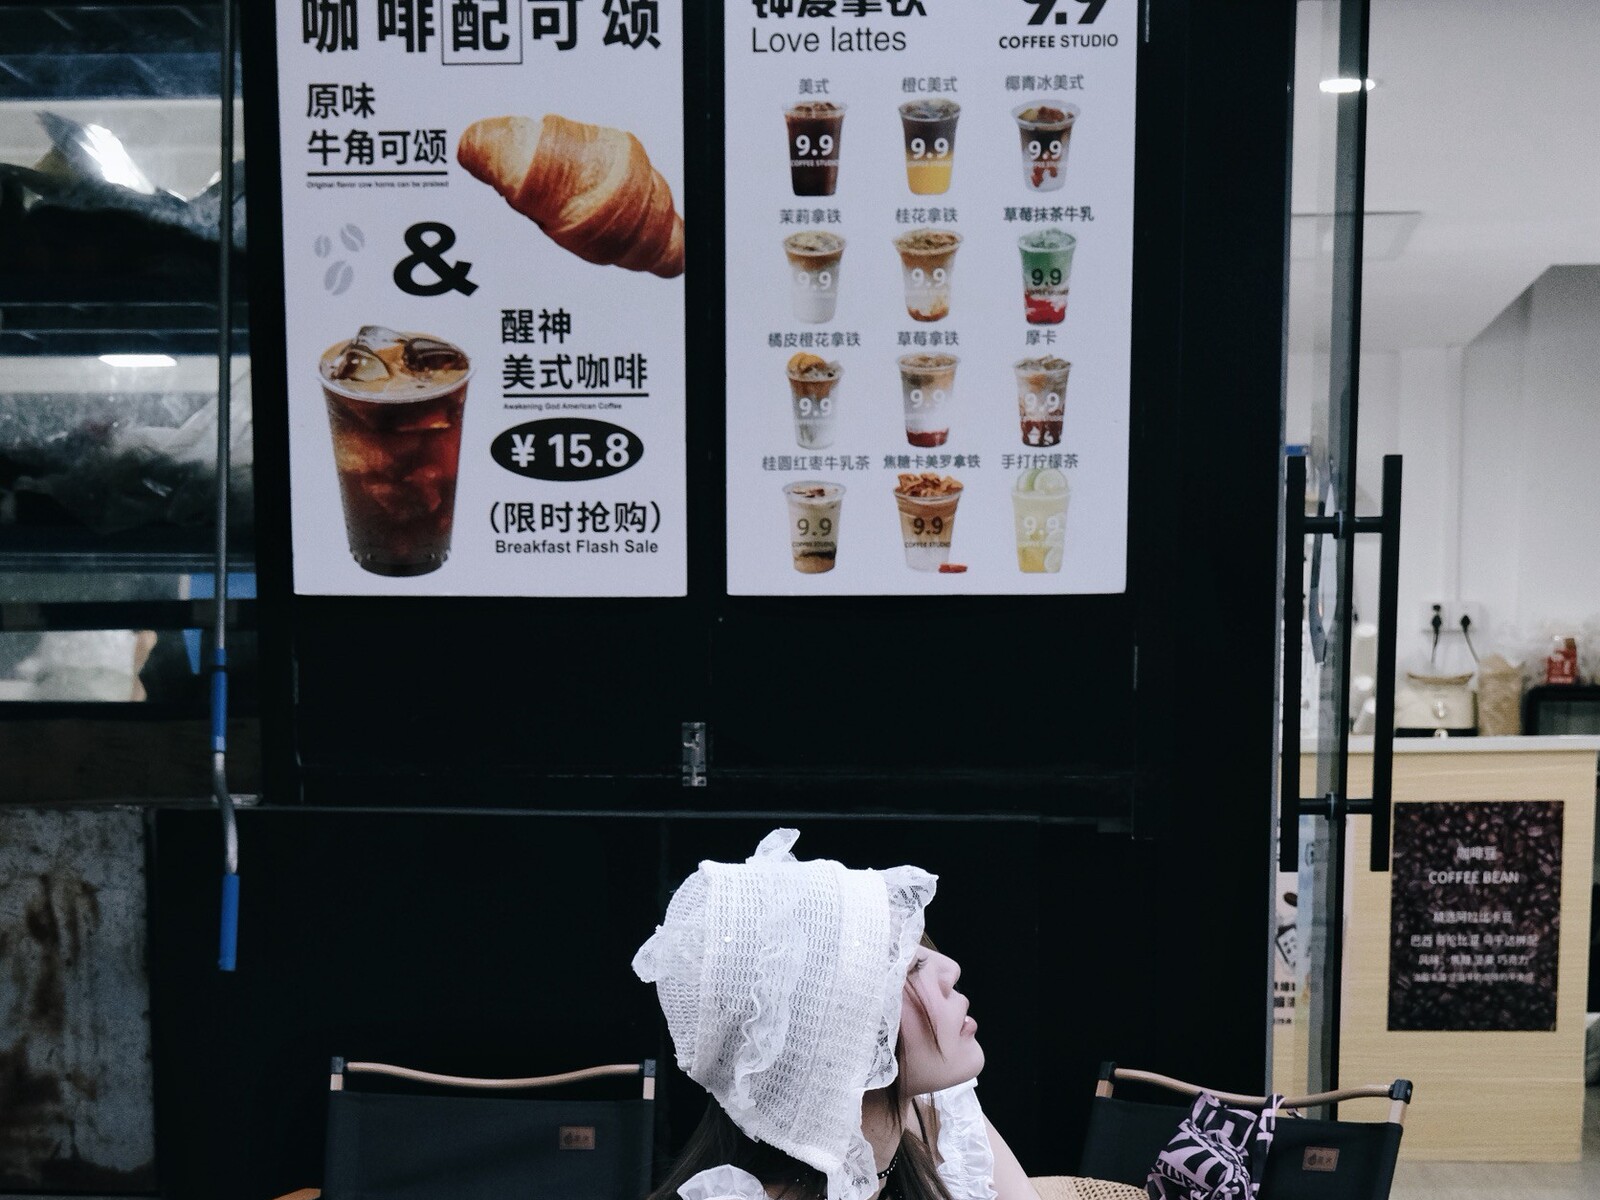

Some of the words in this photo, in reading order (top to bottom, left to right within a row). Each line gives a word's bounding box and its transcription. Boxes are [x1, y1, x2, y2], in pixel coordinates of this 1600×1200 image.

[302, 0, 661, 53] 咖啡配可颂
[753, 27, 820, 52] Love
[831, 26, 907, 52] lattes
[999, 36, 1056, 49] COFFEE
[1060, 34, 1119, 48] STUDIO
[799, 78, 830, 94] 美式
[902, 76, 958, 93] 橙C美式
[306, 82, 376, 119] 原味
[307, 129, 448, 166] 牛角可颂
[796, 134, 834, 156] 9.9
[911, 138, 950, 159] 9.9
[896, 207, 958, 224] 桂花拿铁
[1003, 206, 1095, 223] 草莓抹茶牛乳
[393, 221, 479, 297] &
[1031, 268, 1062, 286] 9.9
[501, 308, 572, 344] 醒神
[897, 331, 959, 347] 草莓拿铁
[1025, 329, 1057, 345] 摩卡
[502, 353, 648, 390] 美式咖啡
[1001, 453, 1079, 469] 手打柠檬茶
[797, 518, 832, 536] 9.9
[913, 517, 944, 535] 9.9
[495, 540, 571, 554] Breakfast
[576, 540, 619, 553] Flash
[624, 539, 659, 553] Sale
[1428, 870, 1479, 885] COFFEE
[1482, 870, 1520, 885] BEAN
